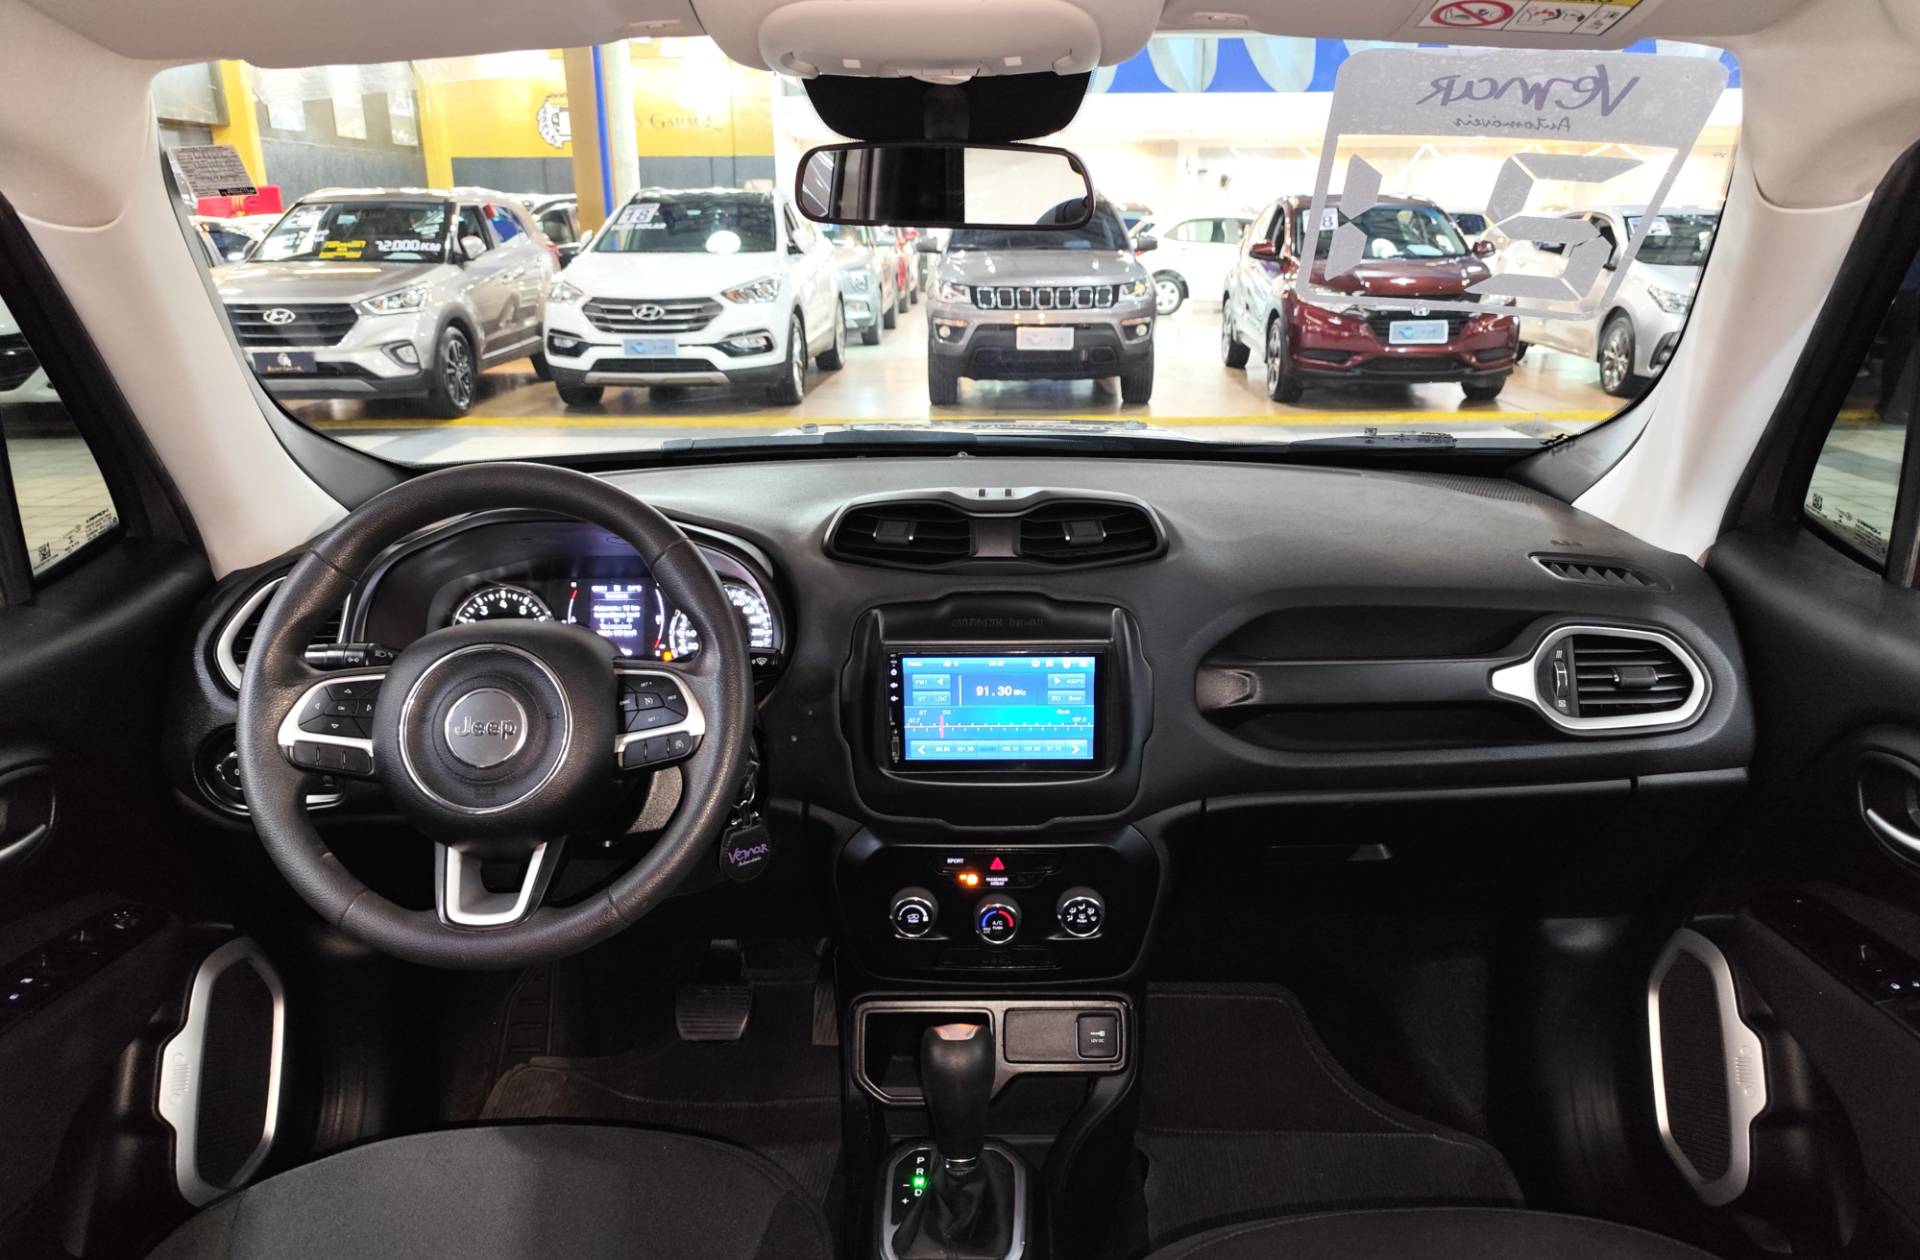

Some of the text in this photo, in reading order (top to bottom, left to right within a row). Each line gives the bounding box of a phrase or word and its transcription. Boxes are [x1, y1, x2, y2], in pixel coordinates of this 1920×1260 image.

[479, 605, 489, 616] 3
[518, 605, 527, 616] 5
[976, 685, 1012, 697] 91.30
[454, 715, 518, 741] Jeep
[916, 1156, 925, 1165] P
[915, 1167, 925, 1176] R
[914, 1177, 925, 1187] N
[914, 1188, 923, 1197] D
